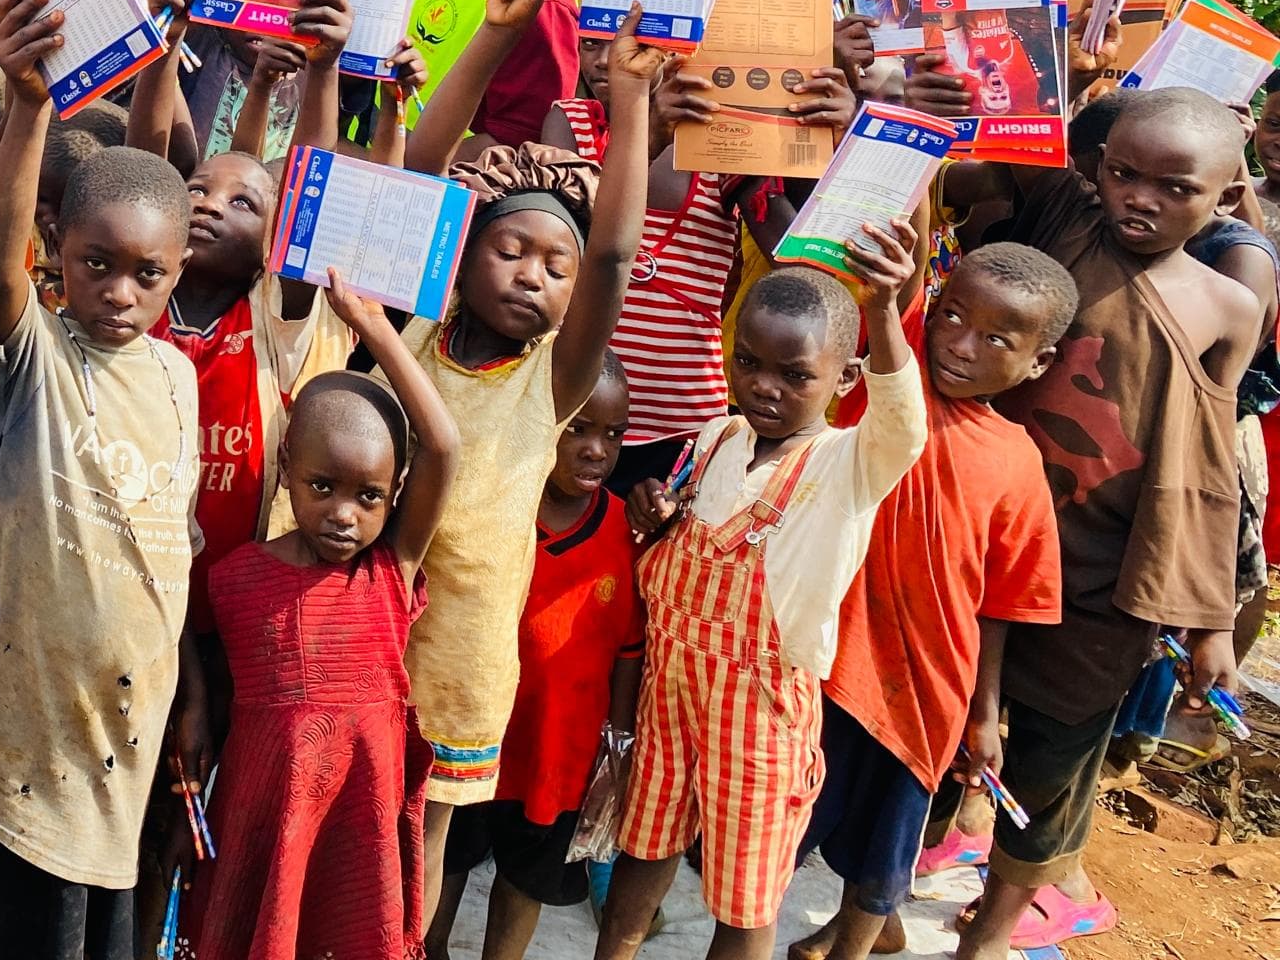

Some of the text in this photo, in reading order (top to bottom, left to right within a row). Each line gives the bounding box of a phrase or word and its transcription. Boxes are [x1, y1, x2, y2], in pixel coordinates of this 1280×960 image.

[248, 10, 290, 26] IGHT
[586, 19, 612, 28] Classic
[61, 87, 82, 105] Classic
[987, 123, 1053, 136] BRIGHT
[308, 155, 321, 182] Classic
[439, 221, 452, 251] METRIC
[48, 495, 63, 508] No
